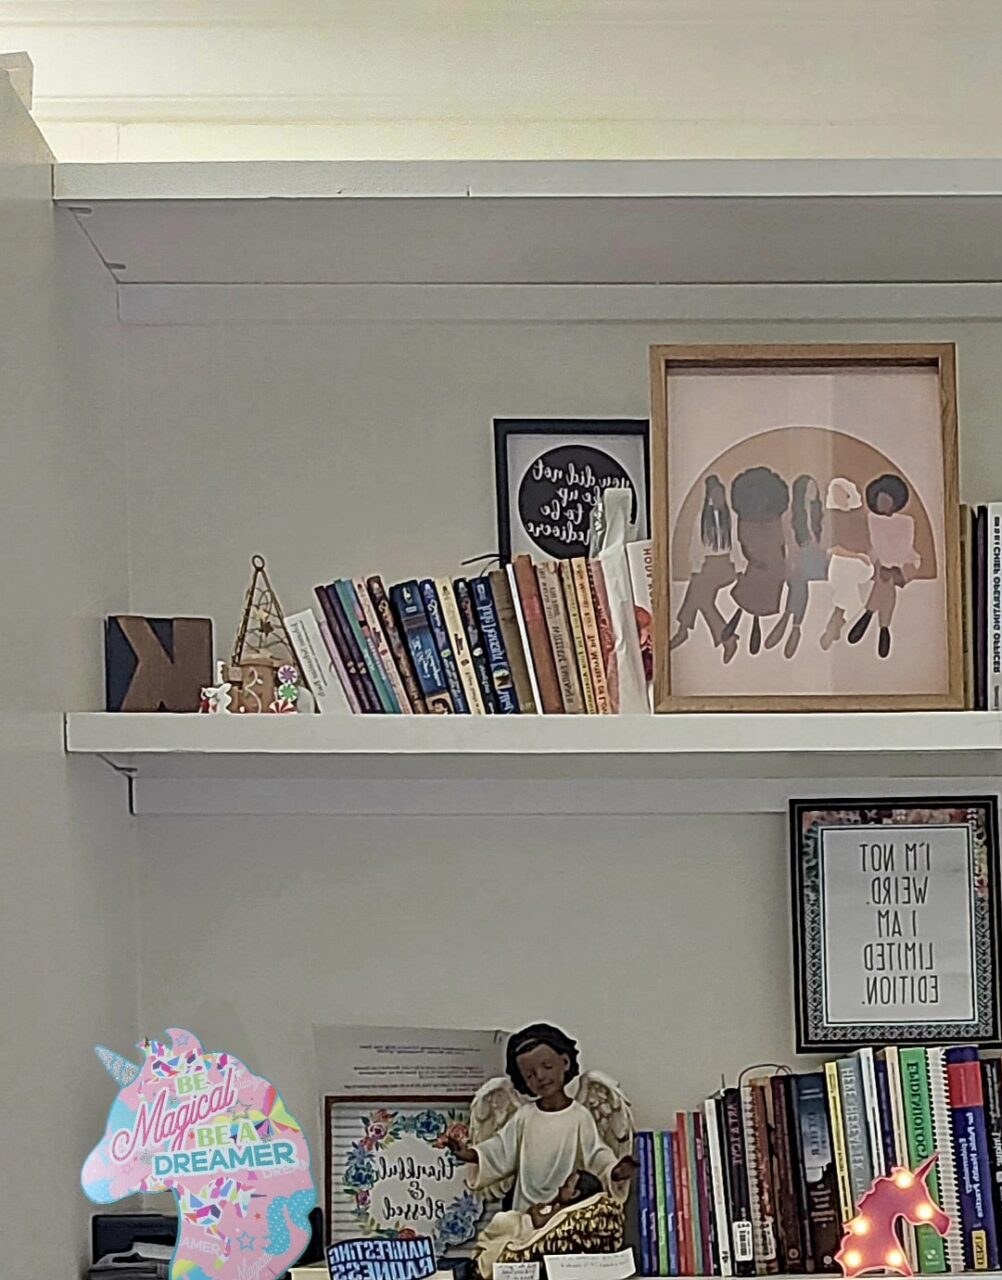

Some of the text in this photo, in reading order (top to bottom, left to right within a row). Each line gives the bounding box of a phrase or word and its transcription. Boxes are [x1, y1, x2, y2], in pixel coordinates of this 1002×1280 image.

[177, 1073, 206, 1096] BE
[112, 1067, 235, 1163] Magical
[197, 1124, 258, 1148] BE A
[154, 1142, 296, 1177] DREAMER
